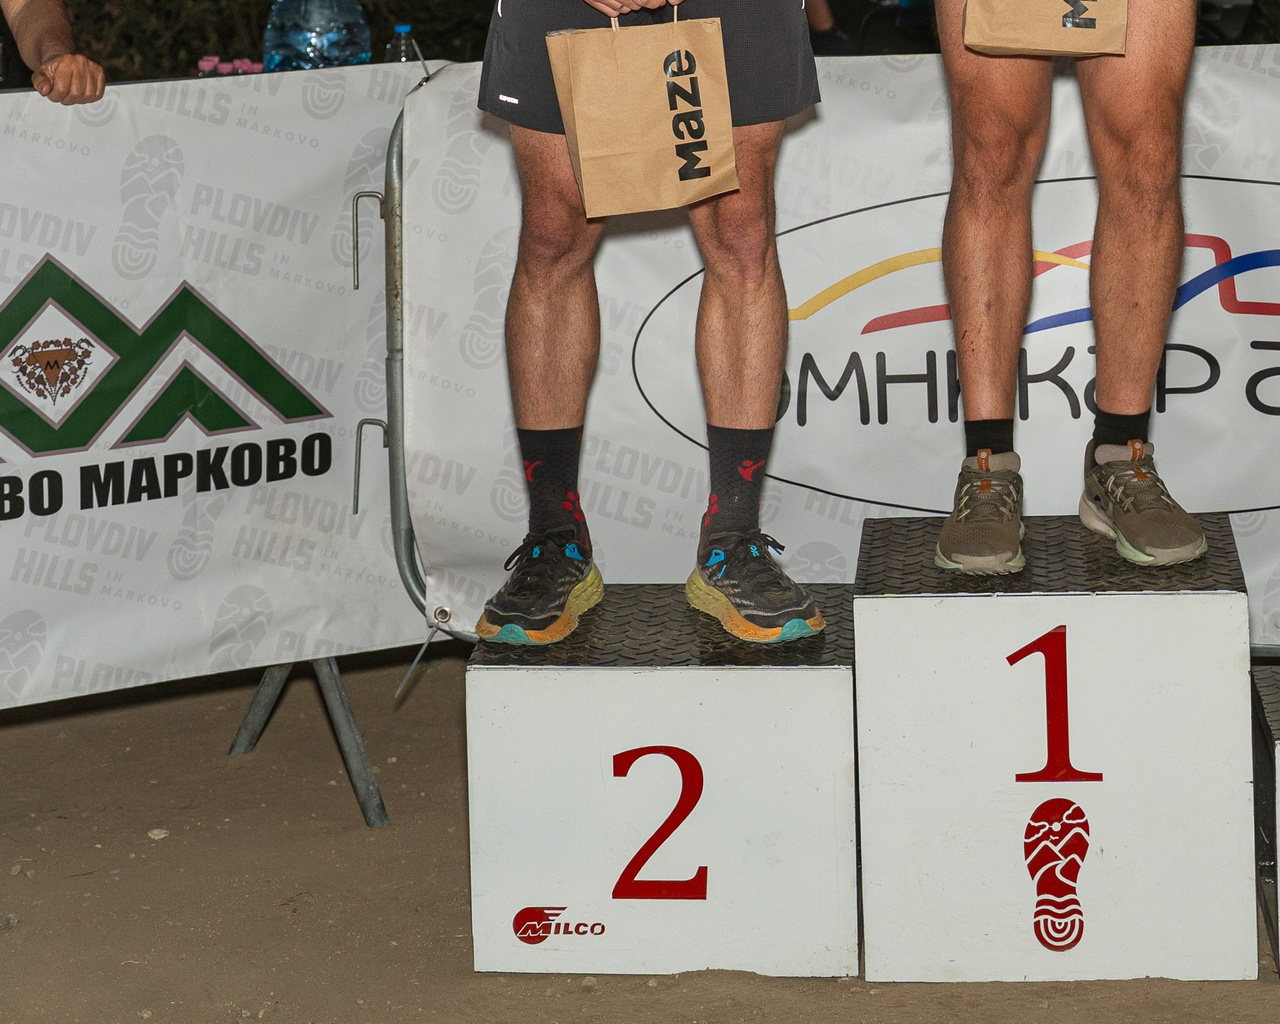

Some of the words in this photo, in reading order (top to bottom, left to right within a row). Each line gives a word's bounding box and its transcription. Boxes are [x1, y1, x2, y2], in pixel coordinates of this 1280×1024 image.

[3, 124, 91, 157] MARKOVO
[236, 117, 321, 149] MARKOVO
[189, 182, 321, 246] PLOVDIV
[179, 223, 267, 277] HILLS
[268, 267, 347, 297] MARKOVO
[79, 432, 332, 511] МАРКОВО
[23, 511, 159, 562] PLOVDIV
[244, 484, 368, 540] PLOVDIV
[11, 548, 99, 595] HILLS
[232, 525, 317, 573] HILLS
[101, 587, 183, 612] MARKOVO
[1005, 624, 1104, 783] 1
[611, 745, 708, 901] 2
[517, 921, 605, 936] MILCO
